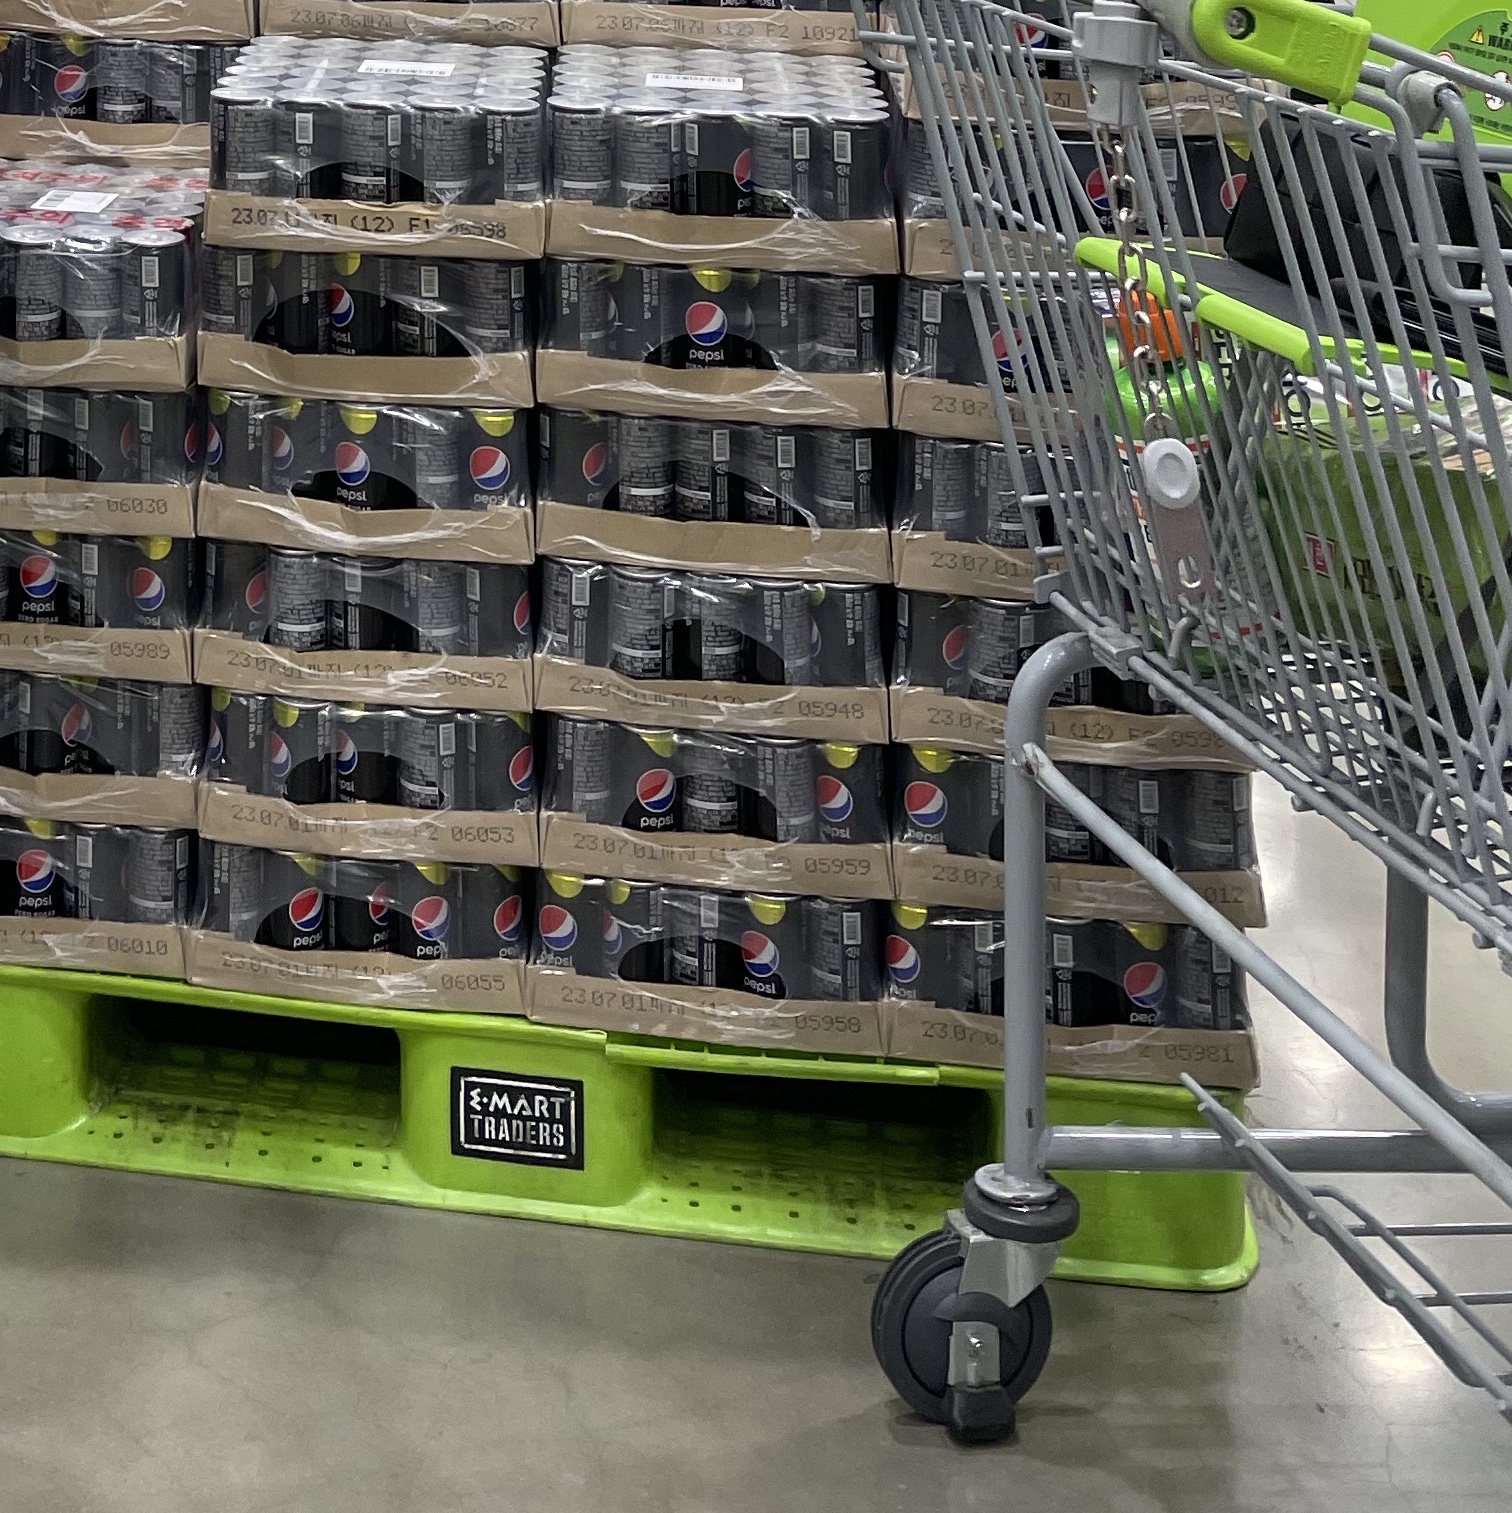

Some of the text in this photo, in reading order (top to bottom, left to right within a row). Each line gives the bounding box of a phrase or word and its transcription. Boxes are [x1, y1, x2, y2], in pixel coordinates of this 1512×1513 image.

[801, 26, 858, 41] 10921
[351, 215, 394, 233] (12)
[409, 217, 433, 234] F1
[689, 347, 725, 362] pepsi
[337, 487, 367, 502] pepsi
[107, 497, 168, 515] 06030
[22, 600, 55, 613] pepsi
[109, 642, 171, 659] 05989
[797, 700, 865, 719] 05948
[640, 813, 674, 829] pepsi
[451, 826, 515, 844] 06053
[804, 857, 871, 876] 05959
[18, 894, 53, 908] pepsi
[106, 937, 168, 955] 06010
[293, 930, 323, 948] pepsi
[441, 973, 505, 992] 06055
[743, 977, 777, 995] pepsi
[1164, 1041, 1235, 1063] 05981
[469, 1114, 565, 1147] TRADERS
